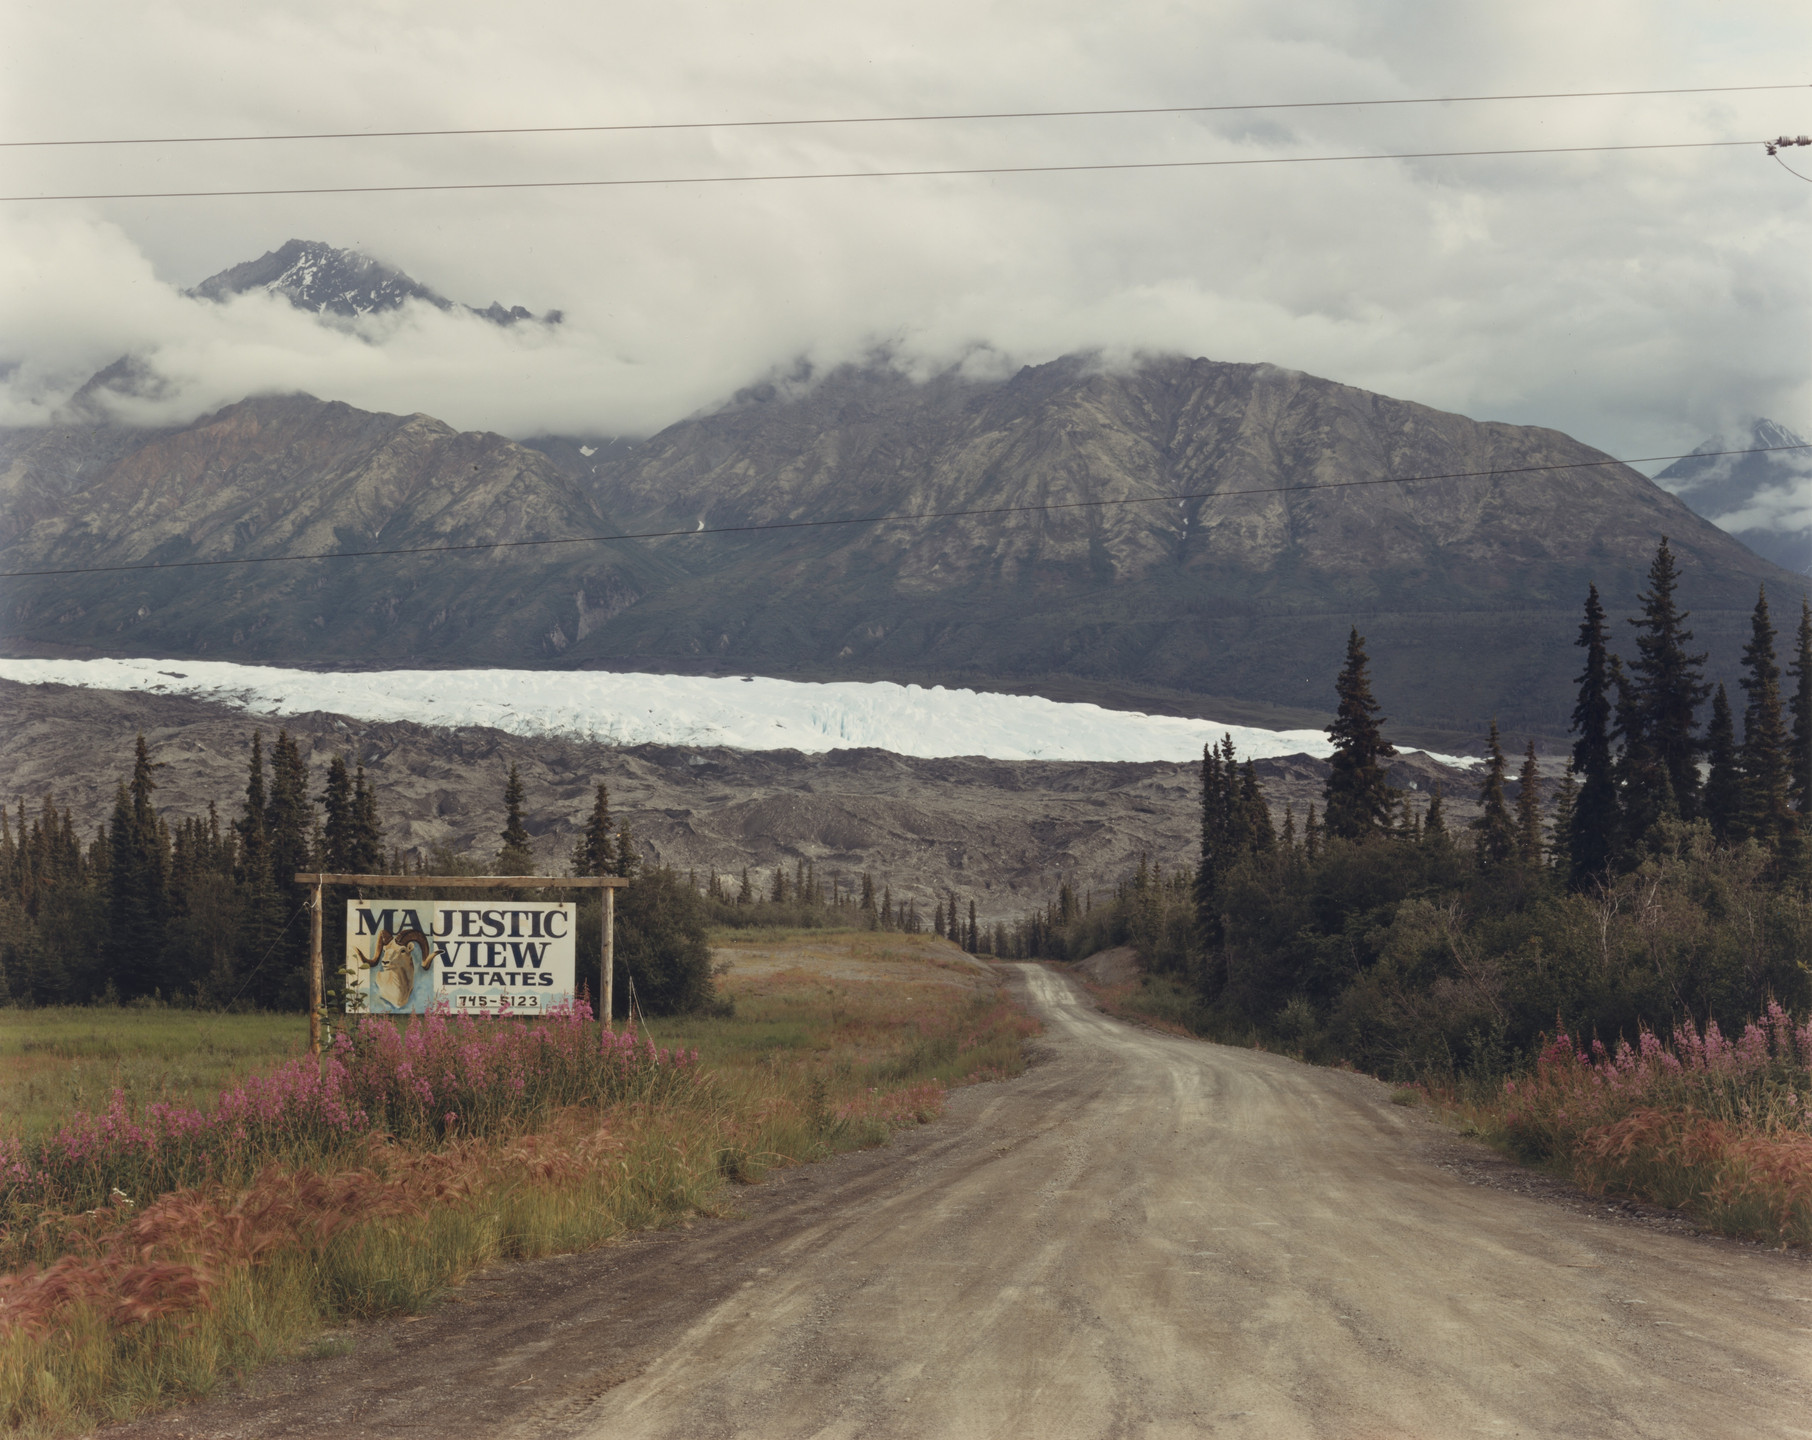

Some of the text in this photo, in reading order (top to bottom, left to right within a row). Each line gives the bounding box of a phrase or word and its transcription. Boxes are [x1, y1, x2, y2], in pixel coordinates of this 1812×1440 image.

[355, 908, 568, 938] MAJESTIC
[433, 941, 552, 969] VIEW
[442, 971, 554, 987] ESTATES
[459, 996, 538, 1007] 745-5123
